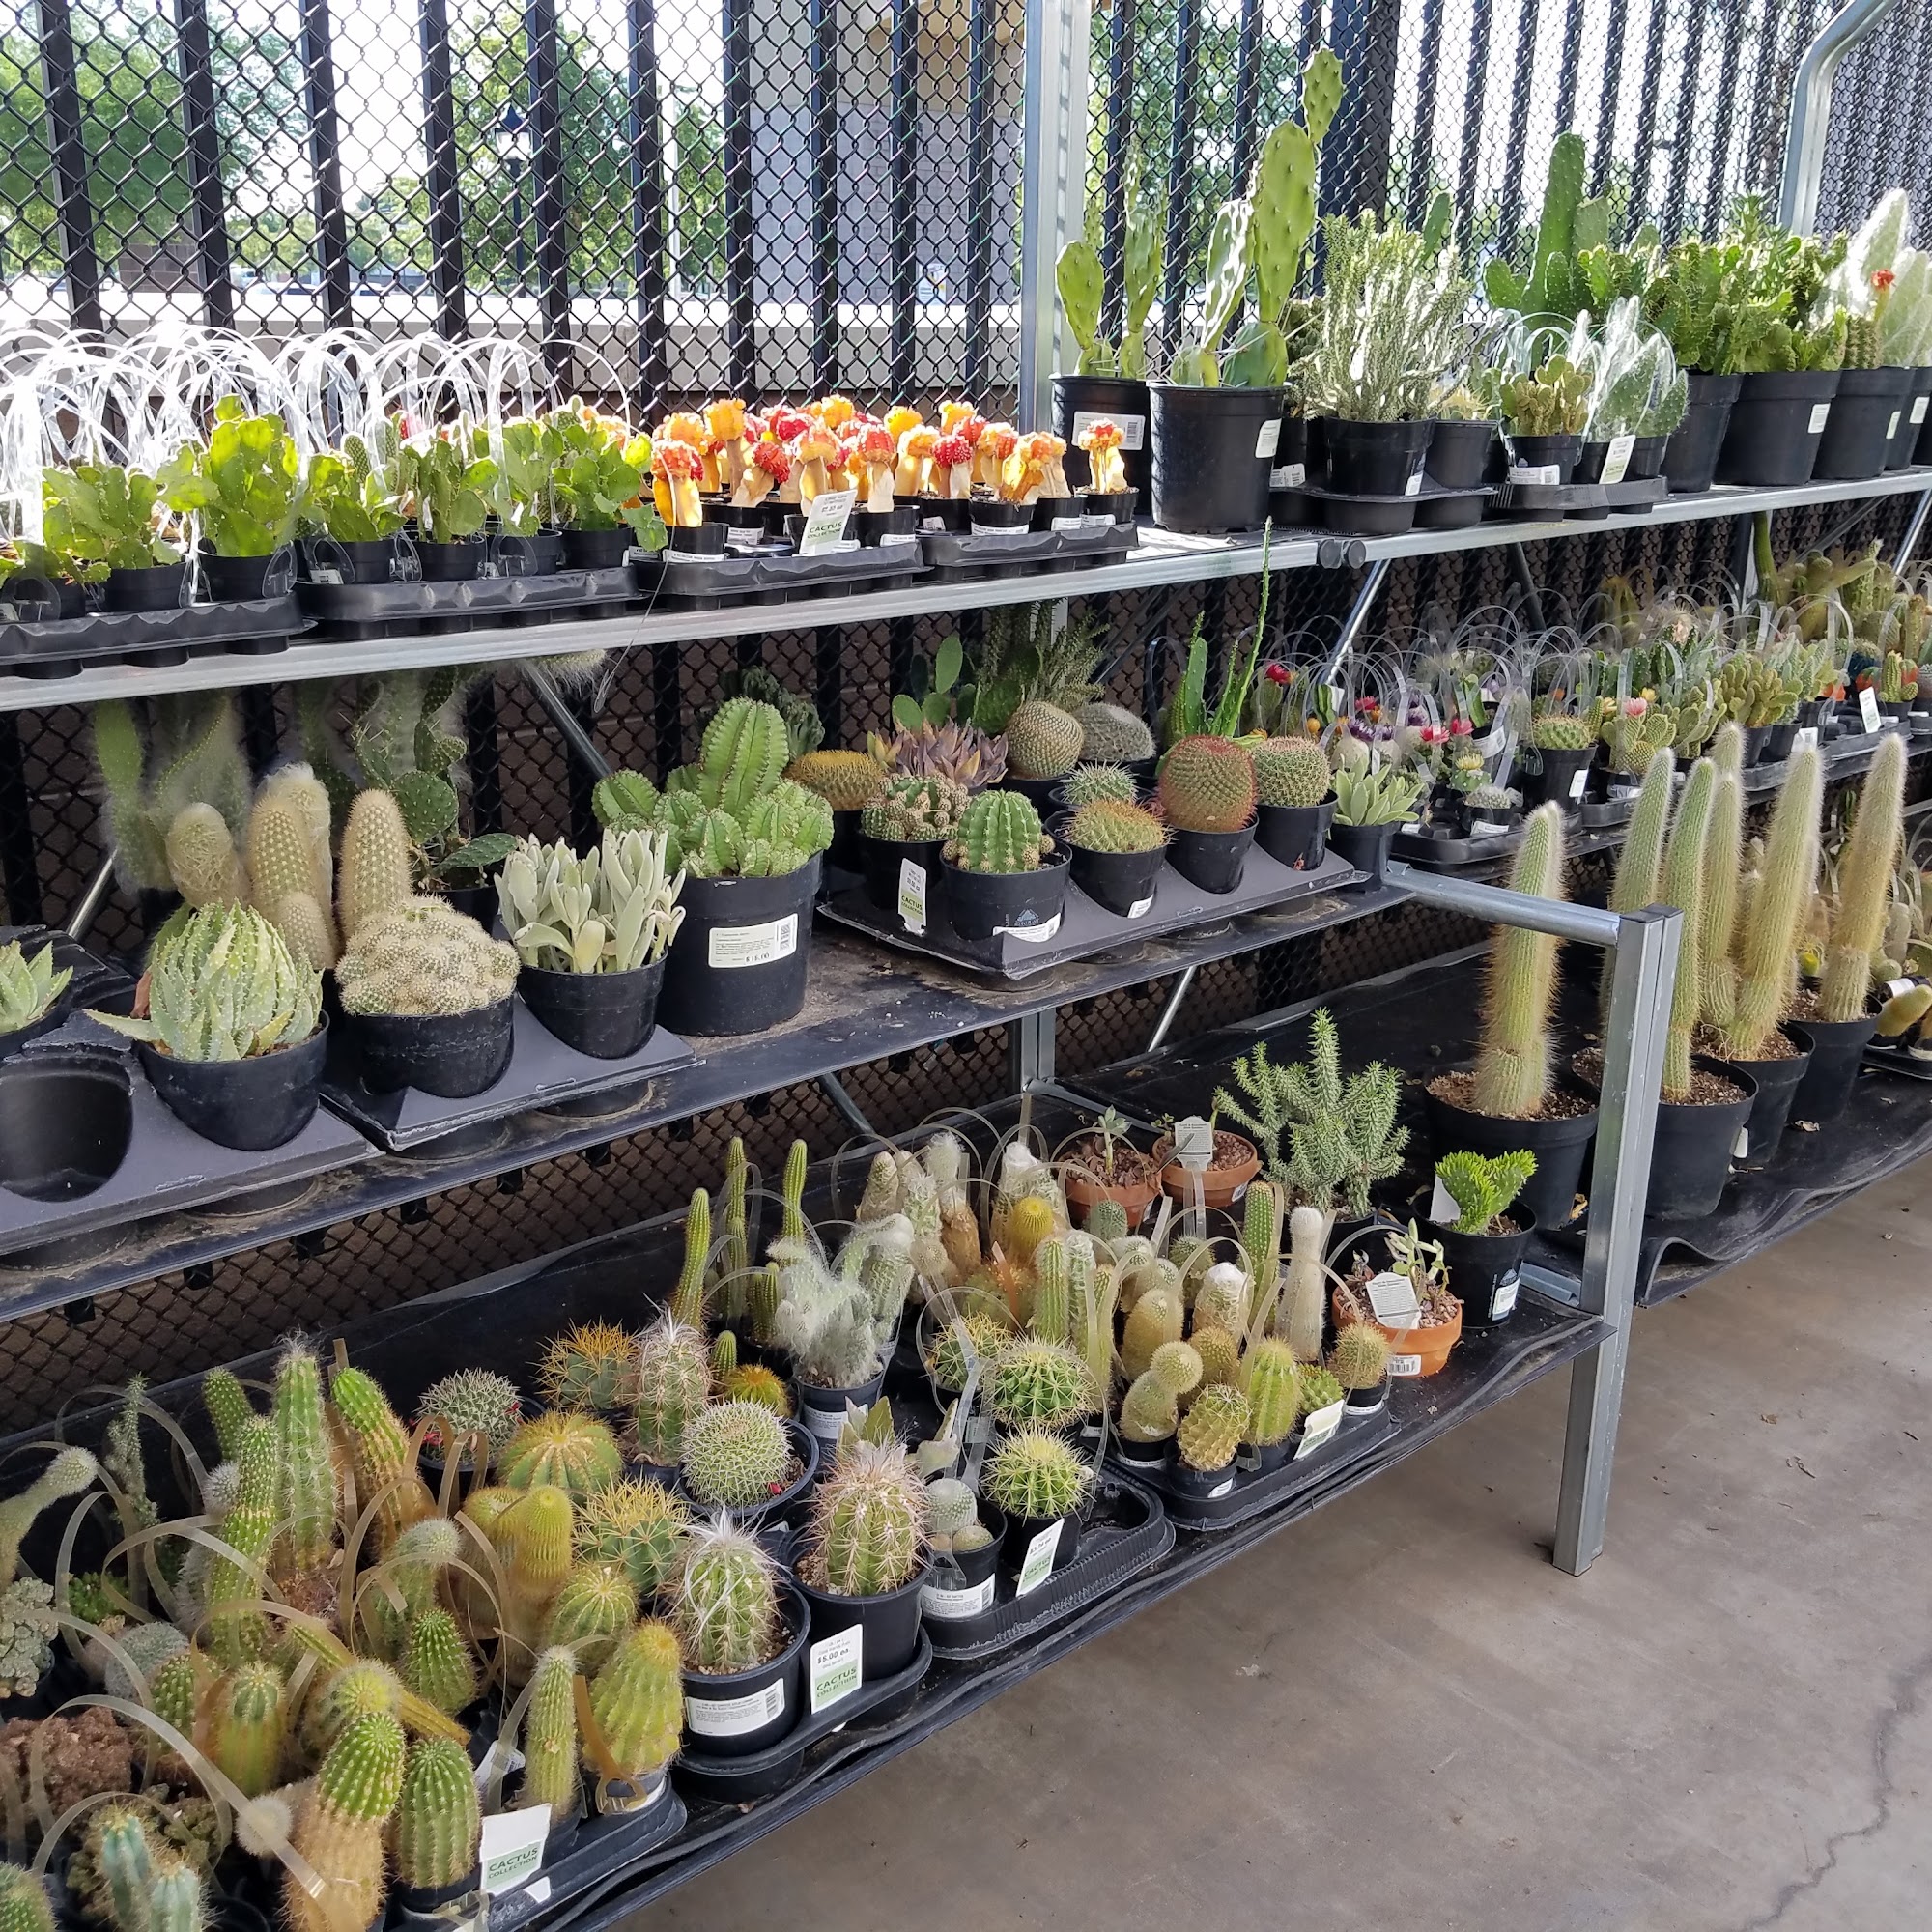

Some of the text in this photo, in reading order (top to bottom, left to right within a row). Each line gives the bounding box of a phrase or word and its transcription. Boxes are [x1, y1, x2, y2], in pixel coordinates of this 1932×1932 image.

[810, 522, 842, 533] CACTUS
[901, 895, 923, 910] CACTUS
[816, 1666, 857, 1691] CACTUS
[816, 1675, 857, 1697] COLLECTION
[489, 1847, 538, 1871] CACTUS
[489, 1855, 538, 1879] COLLECTION
